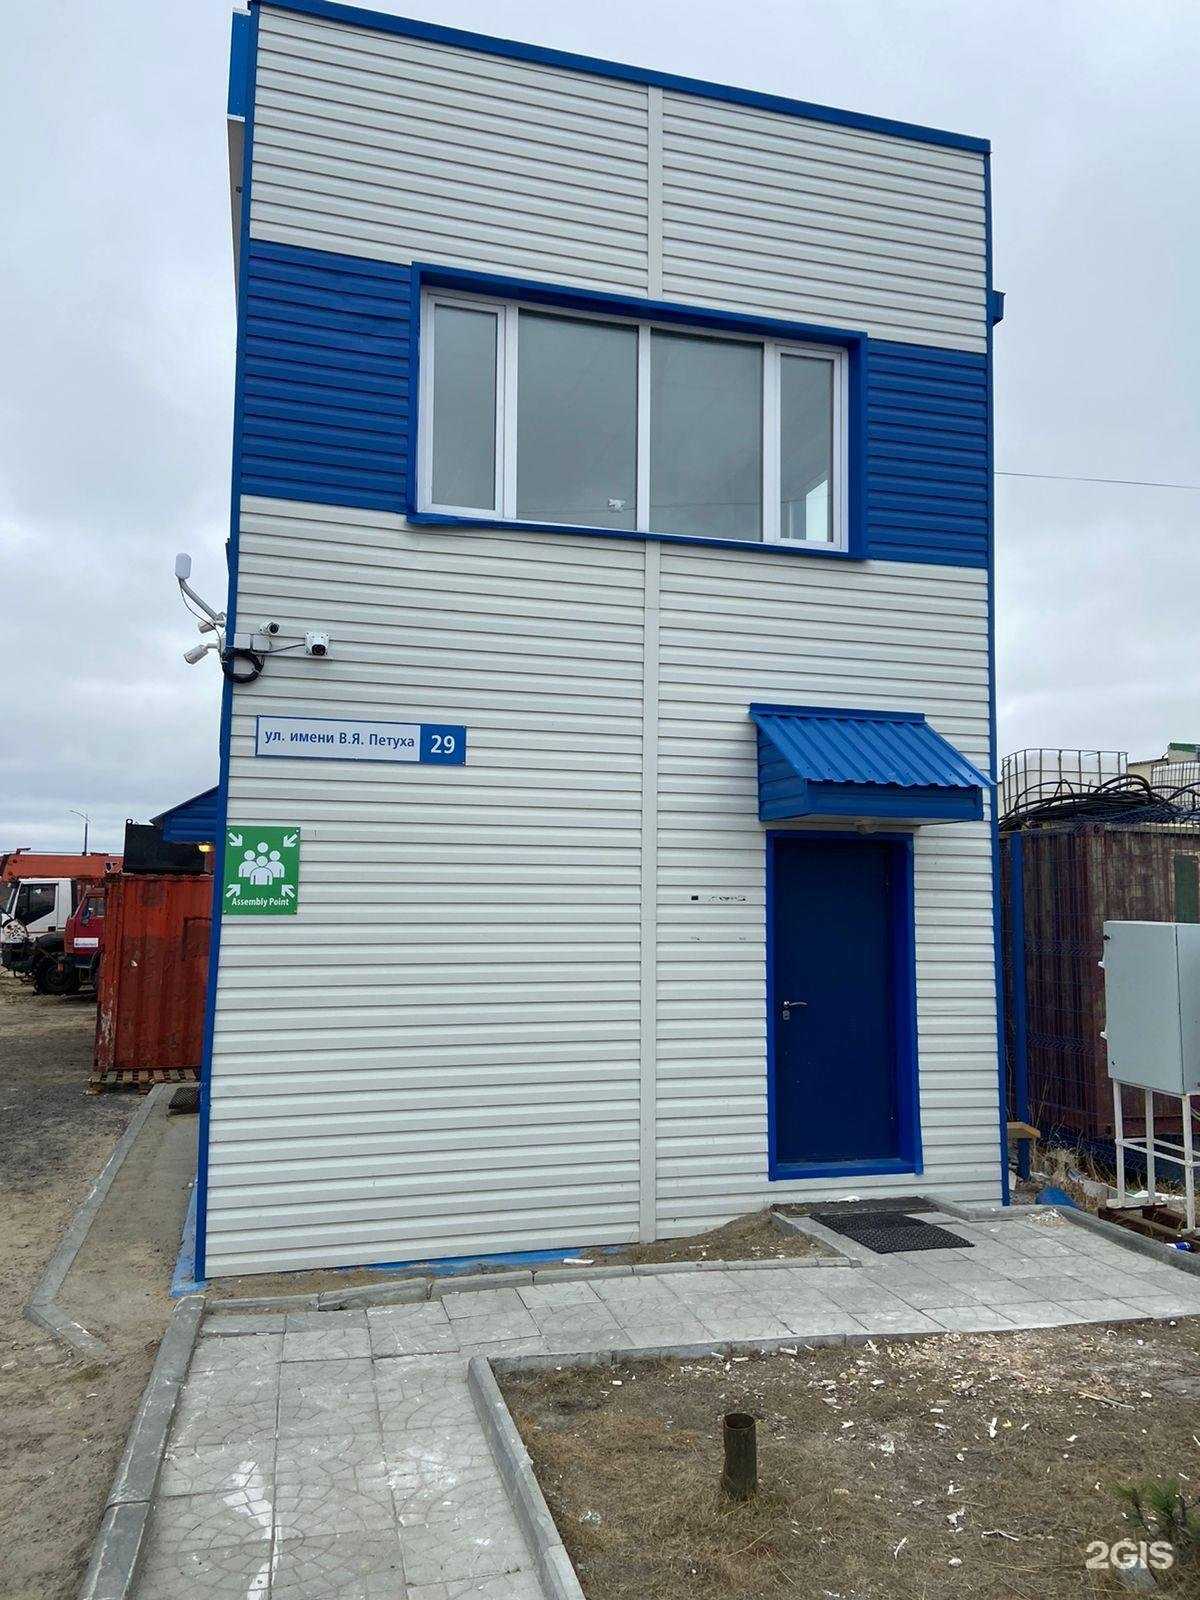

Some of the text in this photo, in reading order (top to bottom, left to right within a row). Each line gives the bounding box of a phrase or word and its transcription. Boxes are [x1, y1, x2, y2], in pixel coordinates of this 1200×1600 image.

[264, 731, 455, 754] ул. имени В.Я. Петуха 29
[231, 897, 289, 907] Assembly Point
